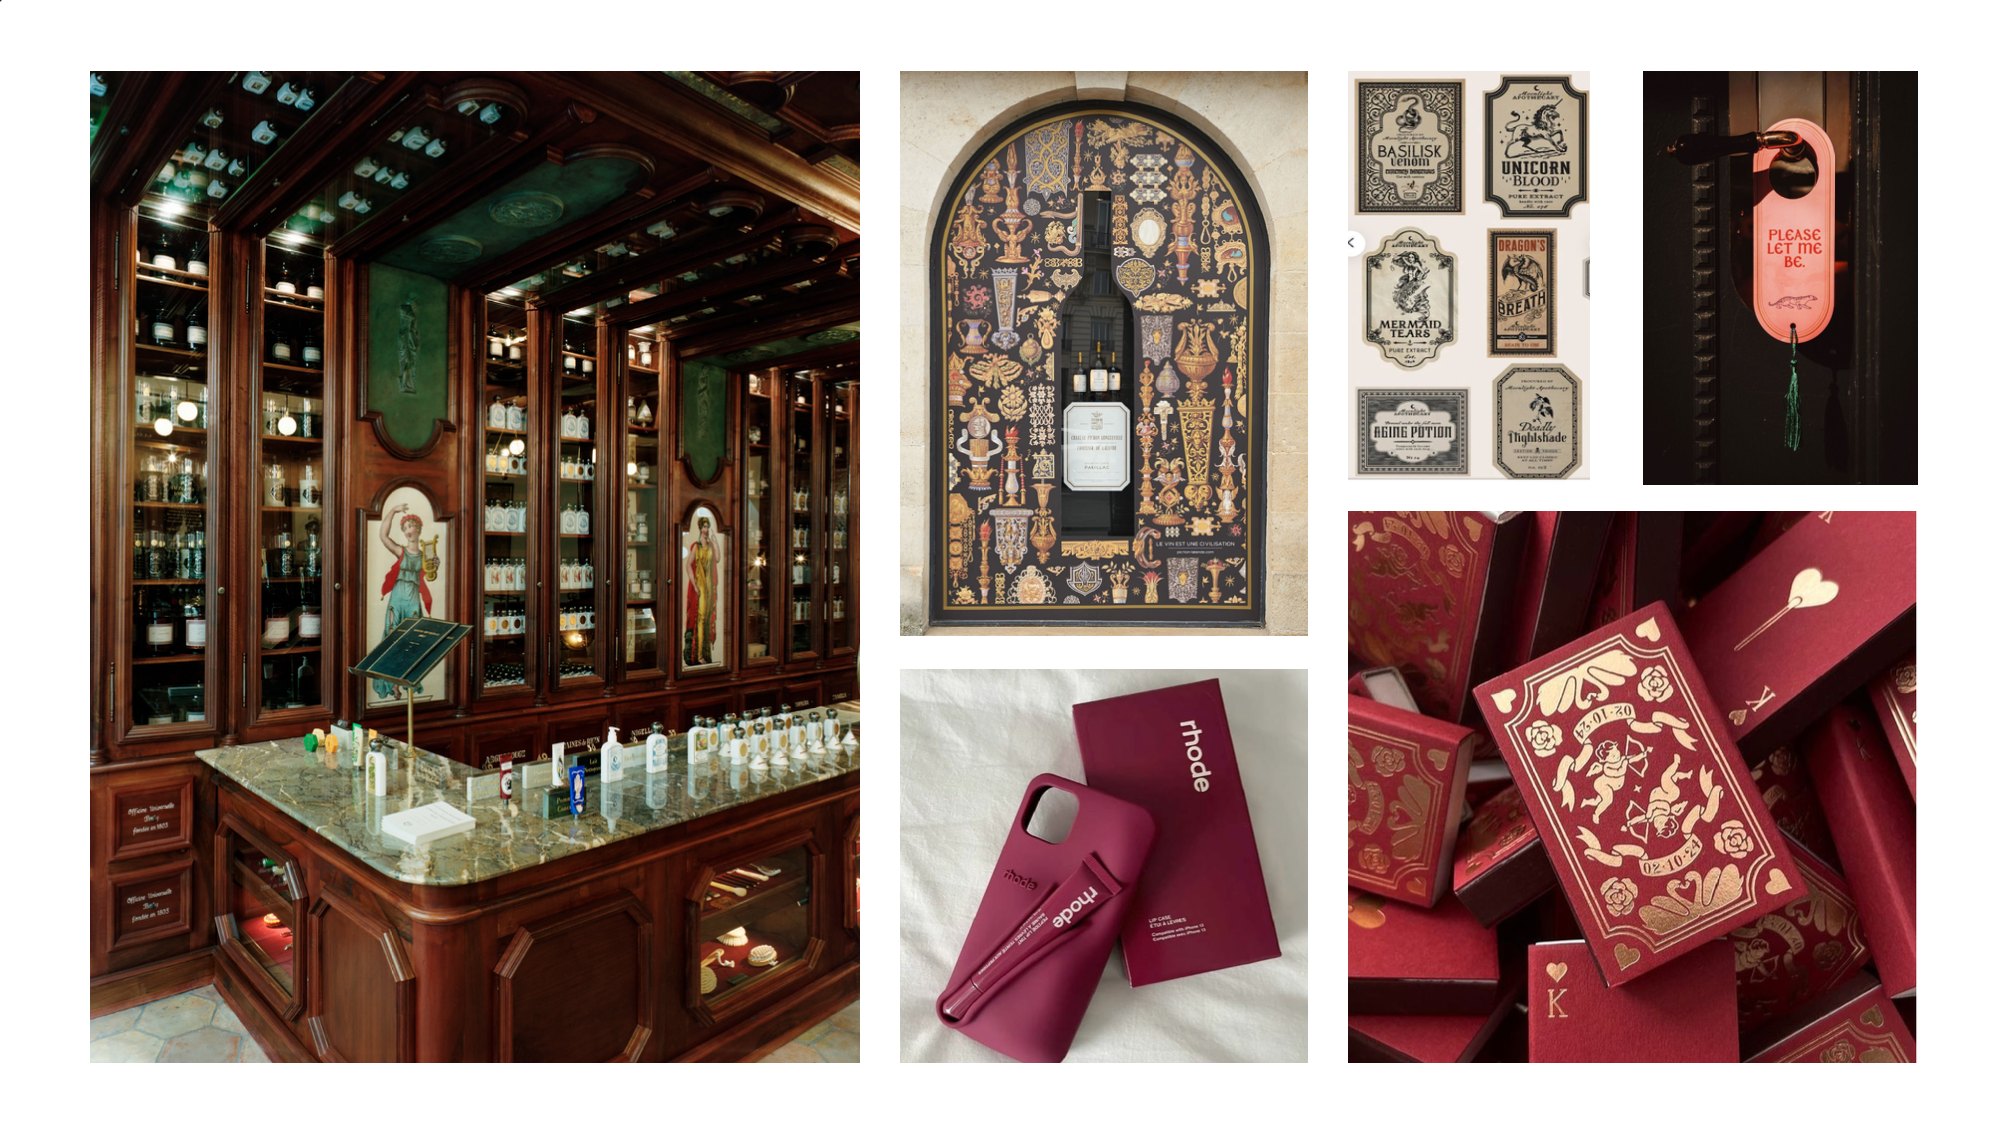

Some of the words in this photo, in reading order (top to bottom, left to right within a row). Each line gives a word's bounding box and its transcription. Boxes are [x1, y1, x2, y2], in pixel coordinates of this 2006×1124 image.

[1378, 144, 1442, 158] BASILISK
[1501, 160, 1571, 175] UNICORN
[1768, 228, 1822, 241] PLEASE
[1498, 239, 1546, 252] DRAGON'S
[1767, 242, 1793, 255] LET
[1798, 242, 1823, 255] ME
[1784, 255, 1806, 268] BE.
[1498, 290, 1546, 316] BREATH
[1380, 320, 1442, 329] MERMAID
[1390, 329, 1431, 338] TEARS
[1374, 426, 1407, 438] AGING
[1411, 426, 1452, 438] POTION
[1519, 421, 1556, 432] Deadly
[1507, 430, 1567, 448] Nightshade
[1745, 685, 1776, 712] K
[1180, 720, 1212, 793] rhode
[1003, 869, 1038, 890] rhode
[1052, 886, 1098, 928] rhode
[1547, 988, 1569, 1018] K
